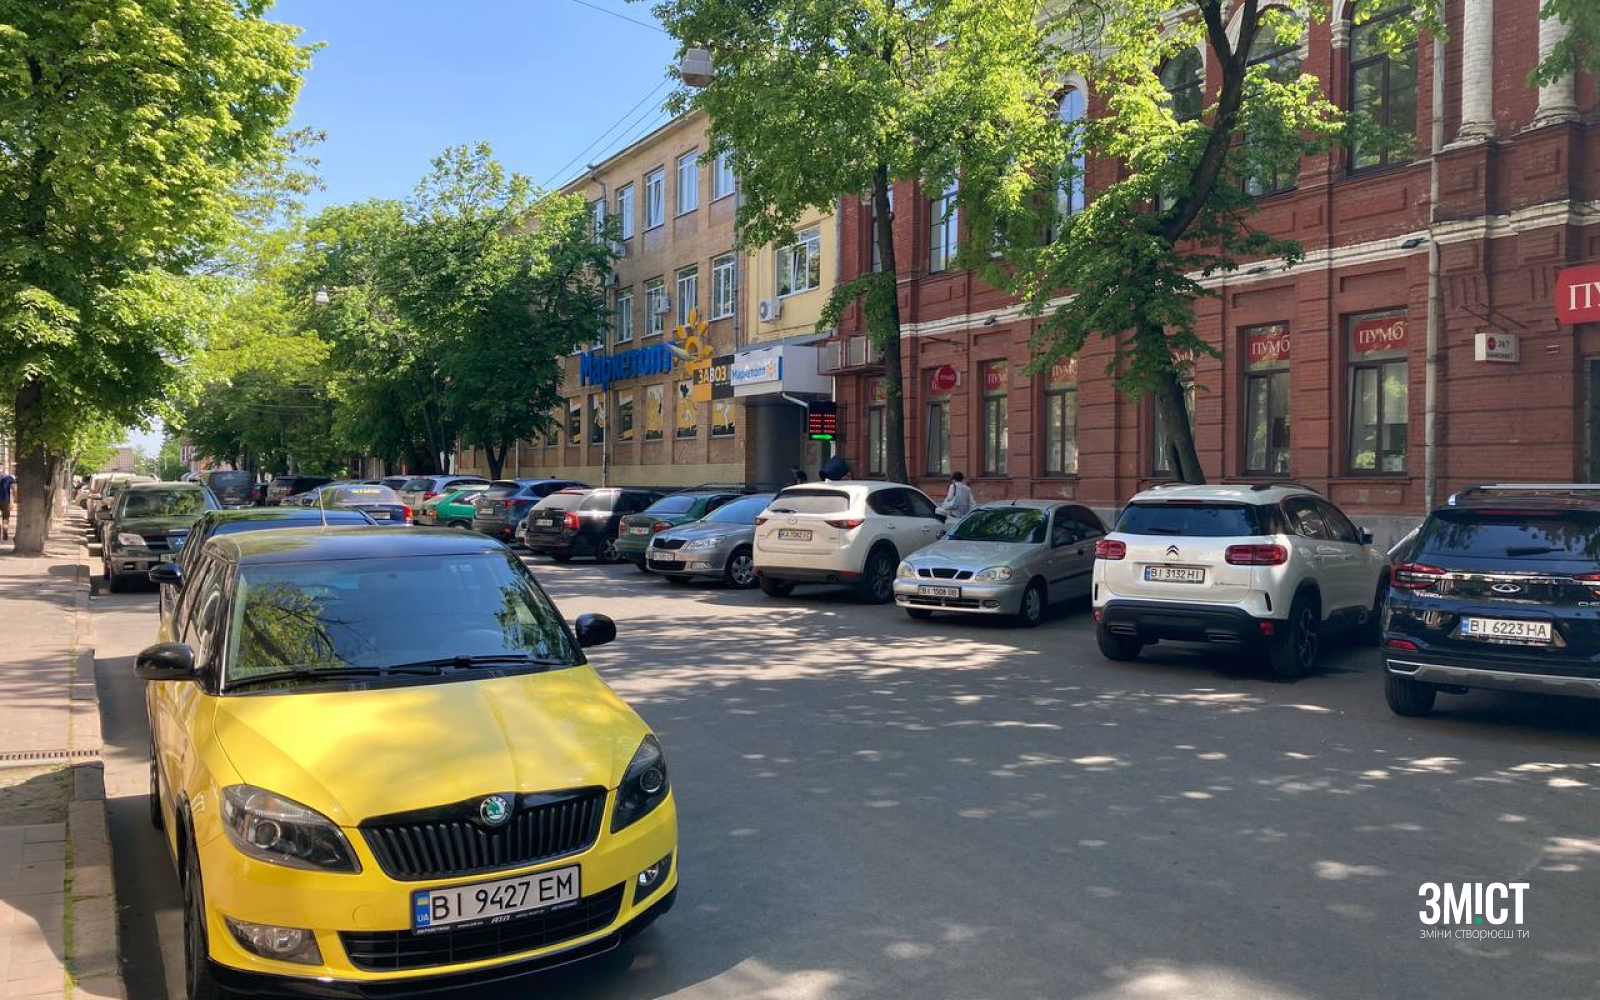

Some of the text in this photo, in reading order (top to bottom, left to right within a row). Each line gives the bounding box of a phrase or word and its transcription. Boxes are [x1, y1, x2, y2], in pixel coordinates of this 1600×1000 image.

[698, 364, 727, 385] ЗАВОЗ
[1165, 569, 1186, 579] 3132
[1470, 619, 1547, 636] BI 6223 HA
[432, 872, 572, 920] BI 9427 EM
[417, 914, 430, 922] UA
